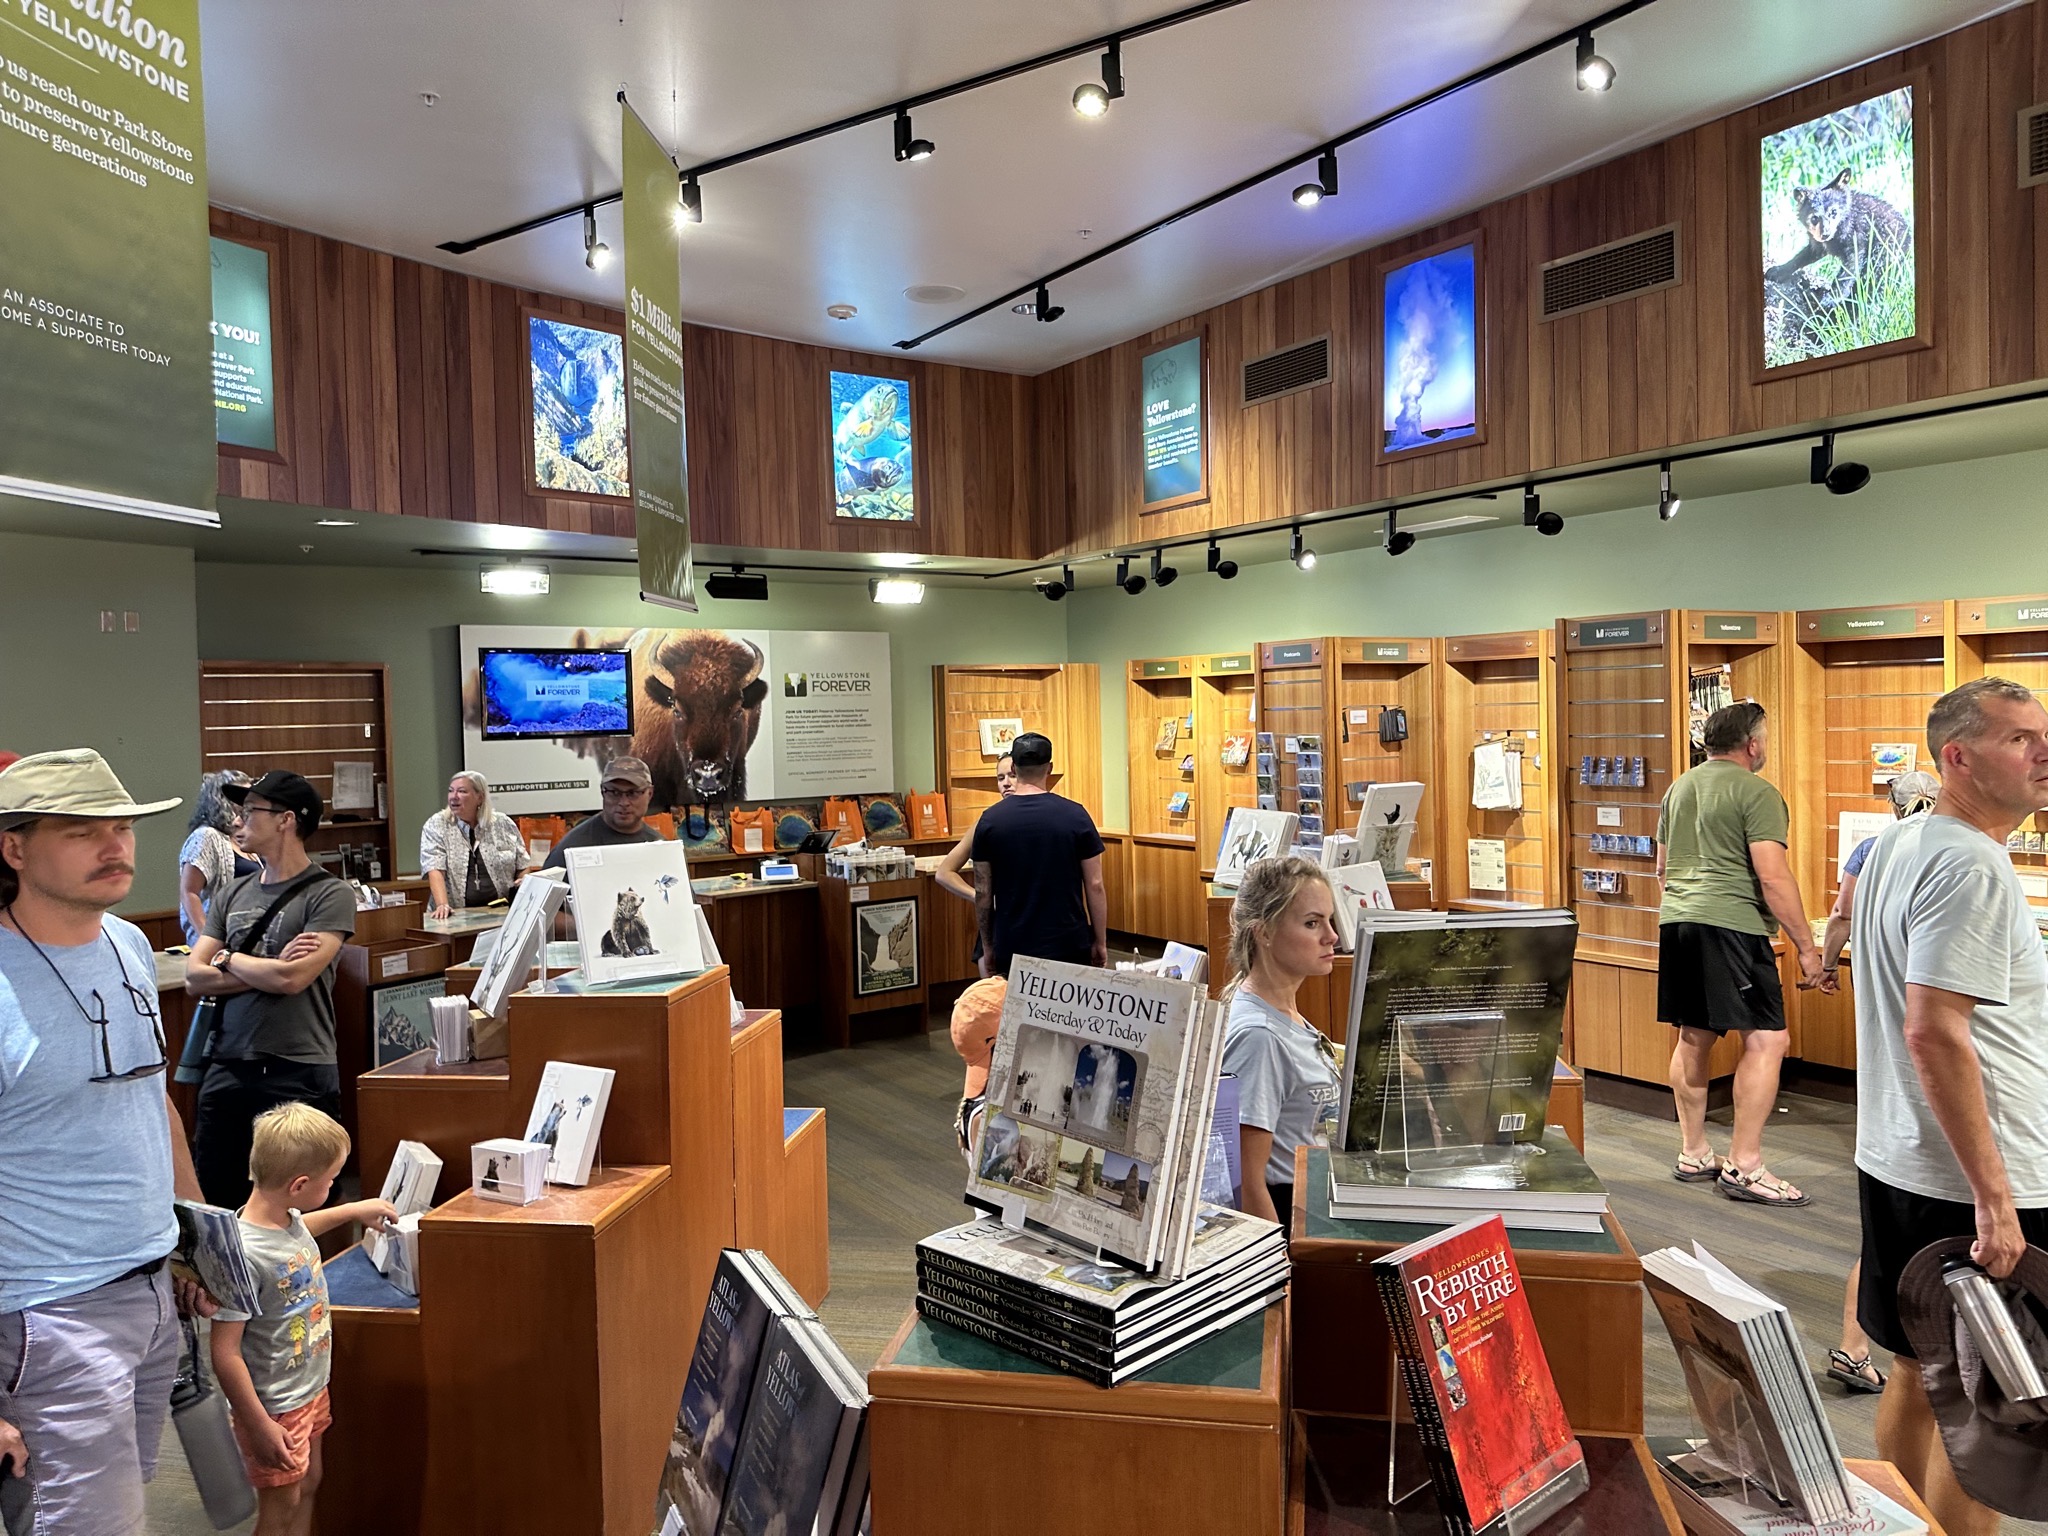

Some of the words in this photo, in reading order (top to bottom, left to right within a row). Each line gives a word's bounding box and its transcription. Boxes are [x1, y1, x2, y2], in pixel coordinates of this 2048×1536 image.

[21, 0, 190, 103] YELLOWSTONE
[8, 60, 28, 82] us
[31, 71, 79, 109] reach
[82, 99, 111, 122] our
[114, 110, 150, 142] Park
[151, 130, 193, 162] Store
[1, 81, 20, 103] to
[23, 94, 99, 141] preserve
[100, 127, 194, 184] Yellowstone
[52, 135, 148, 187] generations
[3, 288, 24, 304] AN
[29, 297, 104, 330] ASSOCIATE
[108, 321, 125, 336] TO
[630, 285, 645, 319] $1
[646, 298, 683, 351] Million
[631, 319, 645, 339] FOR
[37, 318, 47, 331] A
[51, 322, 128, 355] SUPPORTER
[132, 345, 171, 367] TODAY
[219, 322, 260, 346] YOU!
[1146, 399, 1170, 416] LOVE
[1604, 630, 1630, 638] FOREVER
[1846, 620, 1885, 628] Yellowstone
[812, 680, 871, 692] FOREVER
[506, 783, 549, 792] SUPPORTER
[1019, 970, 1168, 1025] YELLOWSTONE
[1027, 1001, 1087, 1035] Yesterday
[1088, 1015, 1105, 1034] &
[1106, 1018, 1147, 1049] Today
[923, 1249, 1000, 1286] YELLOWSTONE
[924, 1265, 1000, 1305] YELLOWSTONE
[1411, 1250, 1510, 1317] REBIRTH
[1433, 1248, 1490, 1280] YELLOWSTONE'S
[717, 1274, 738, 1309] ATLAS
[926, 1281, 1000, 1323] YELLOWSTONE
[1443, 1298, 1468, 1327] BY
[1469, 1272, 1517, 1312] FIRE
[923, 1301, 998, 1343] YELLOWSTONE
[775, 1348, 800, 1392] ATLAS
